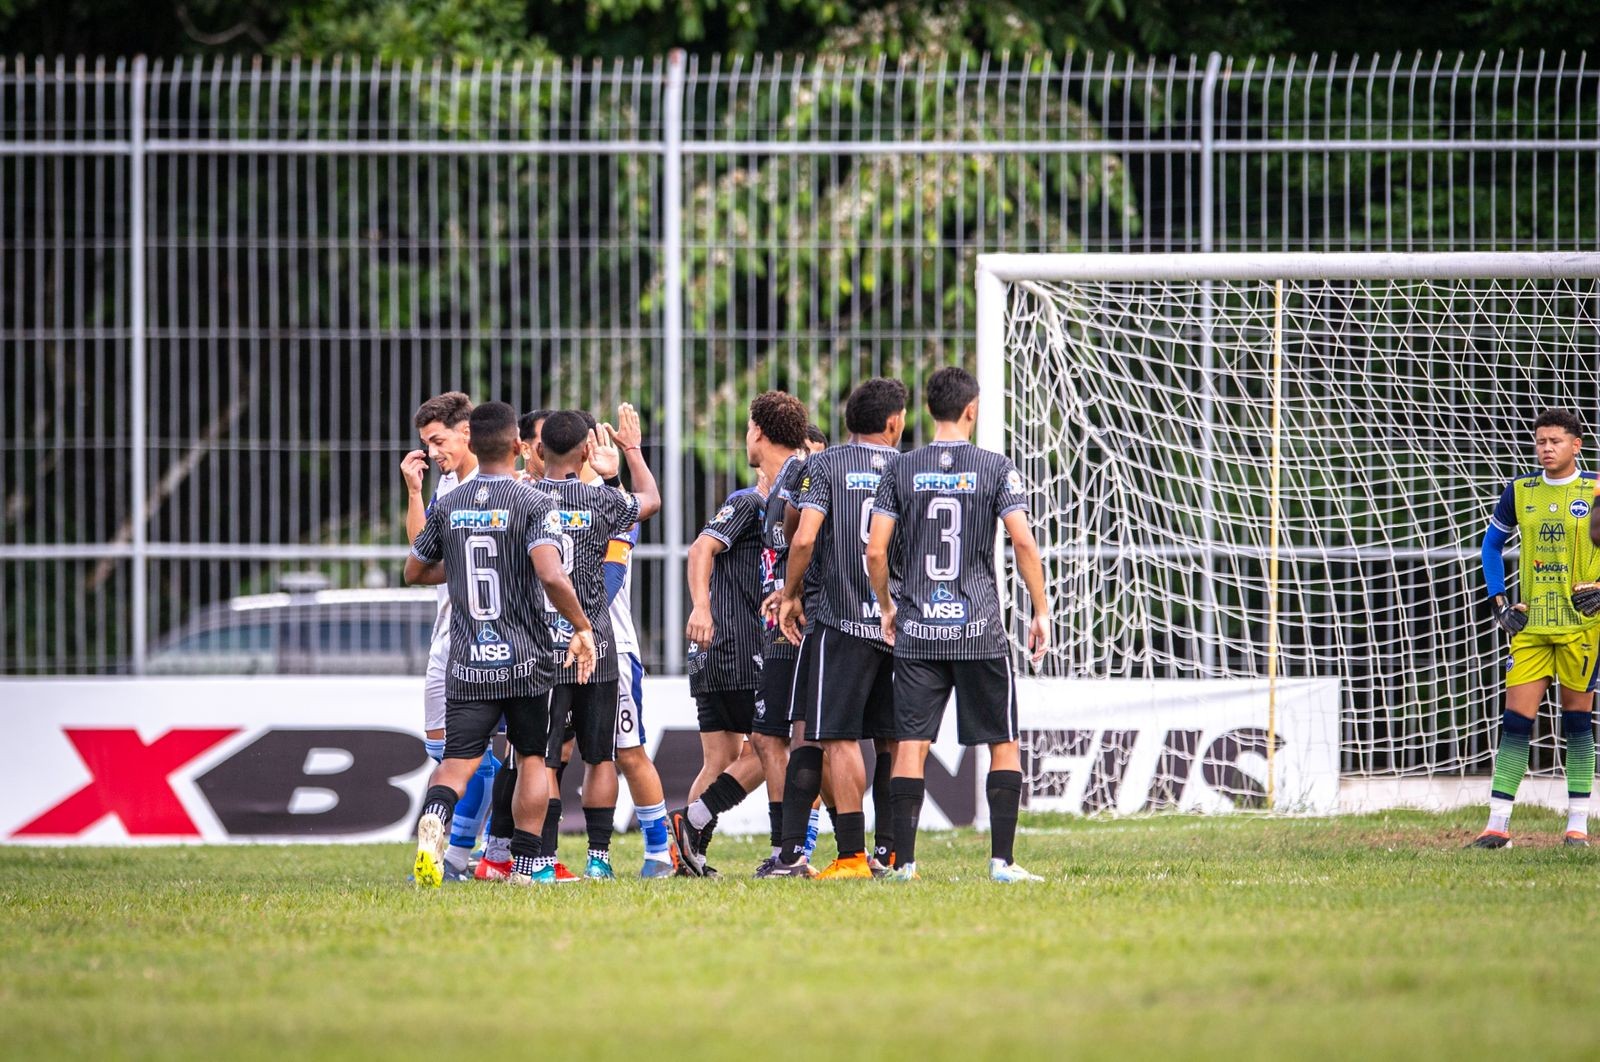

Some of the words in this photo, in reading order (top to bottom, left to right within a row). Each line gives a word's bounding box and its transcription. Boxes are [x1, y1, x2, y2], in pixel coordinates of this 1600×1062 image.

[914, 472, 977, 492] SHEKINAH
[450, 509, 509, 530] SHEKINAH
[926, 498, 962, 581] 3
[465, 535, 501, 622] 6
[923, 603, 964, 619] MSB
[903, 619, 961, 641] SANTOS
[966, 618, 987, 639] AP
[470, 643, 511, 662] MSB
[451, 661, 509, 684] SANTOS
[513, 658, 537, 680] AP
[1581, 655, 1589, 677] 1
